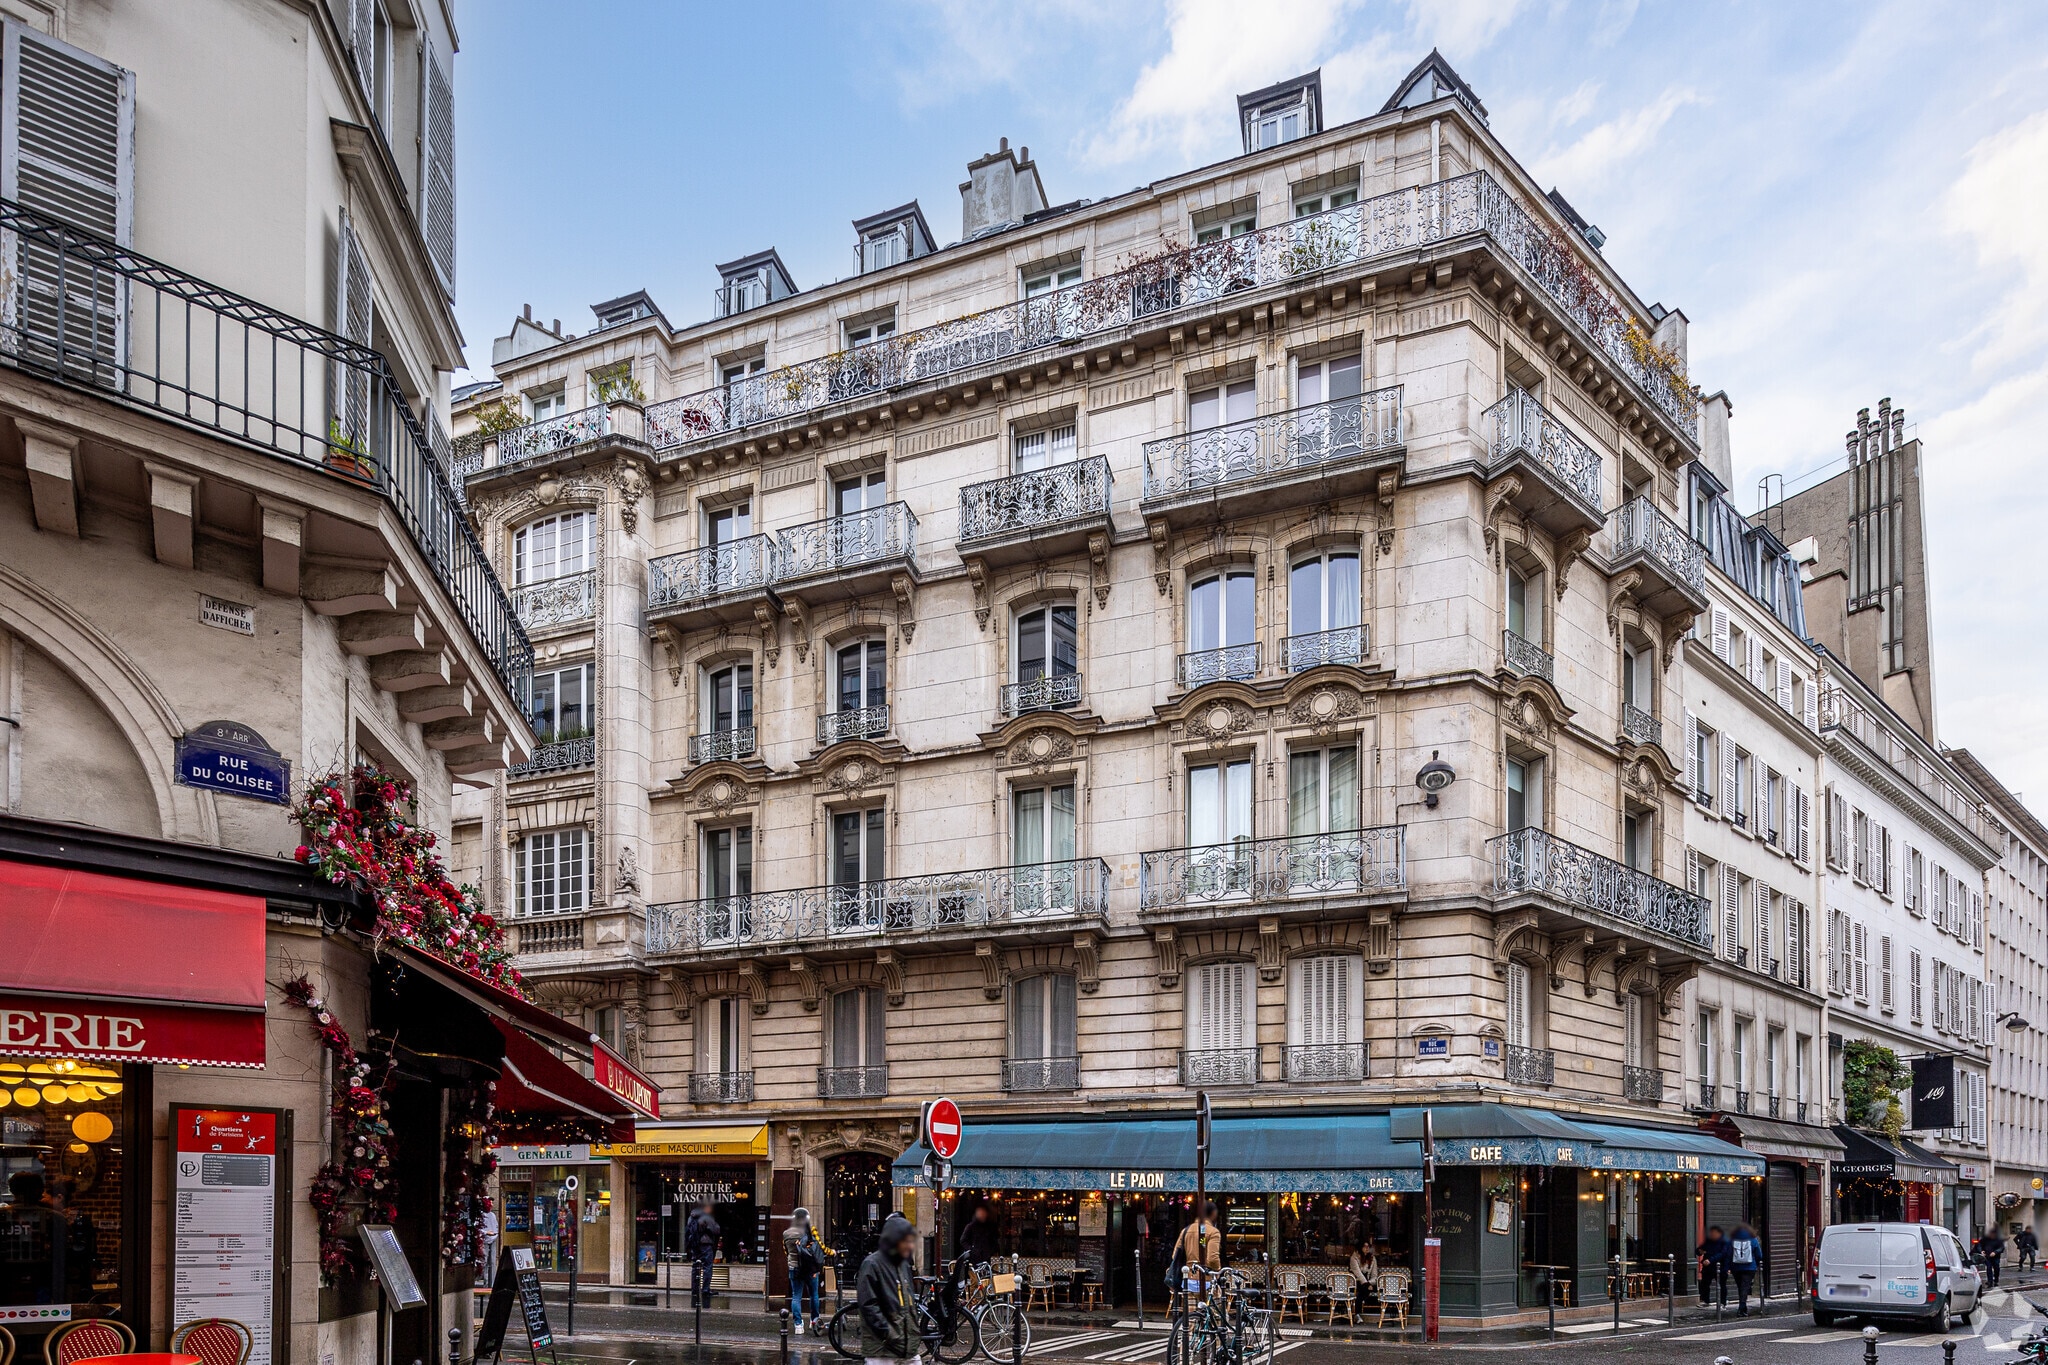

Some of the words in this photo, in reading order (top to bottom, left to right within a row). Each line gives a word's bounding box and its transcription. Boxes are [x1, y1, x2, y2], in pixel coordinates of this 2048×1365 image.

[203, 610, 251, 630] D'AFFICHER
[219, 755, 249, 770] RUE
[192, 766, 211, 779] DU
[216, 771, 273, 791] COLISÉE
[0, 1009, 147, 1052] ERIE
[620, 1144, 661, 1154] COIFFURE
[668, 1143, 718, 1153] MASCULINE
[1470, 1146, 1503, 1161] CAFE
[1557, 1147, 1573, 1161] CAFE
[1602, 1155, 1614, 1165] CAFE
[1676, 1155, 1685, 1169] LE
[1685, 1156, 1700, 1170] PAON
[1110, 1172, 1126, 1188] LE
[1130, 1172, 1164, 1188] PAON
[1369, 1177, 1394, 1188] CAFE
[678, 1183, 732, 1193] COIFFURE
[1448, 1209, 1471, 1222] HOUR
